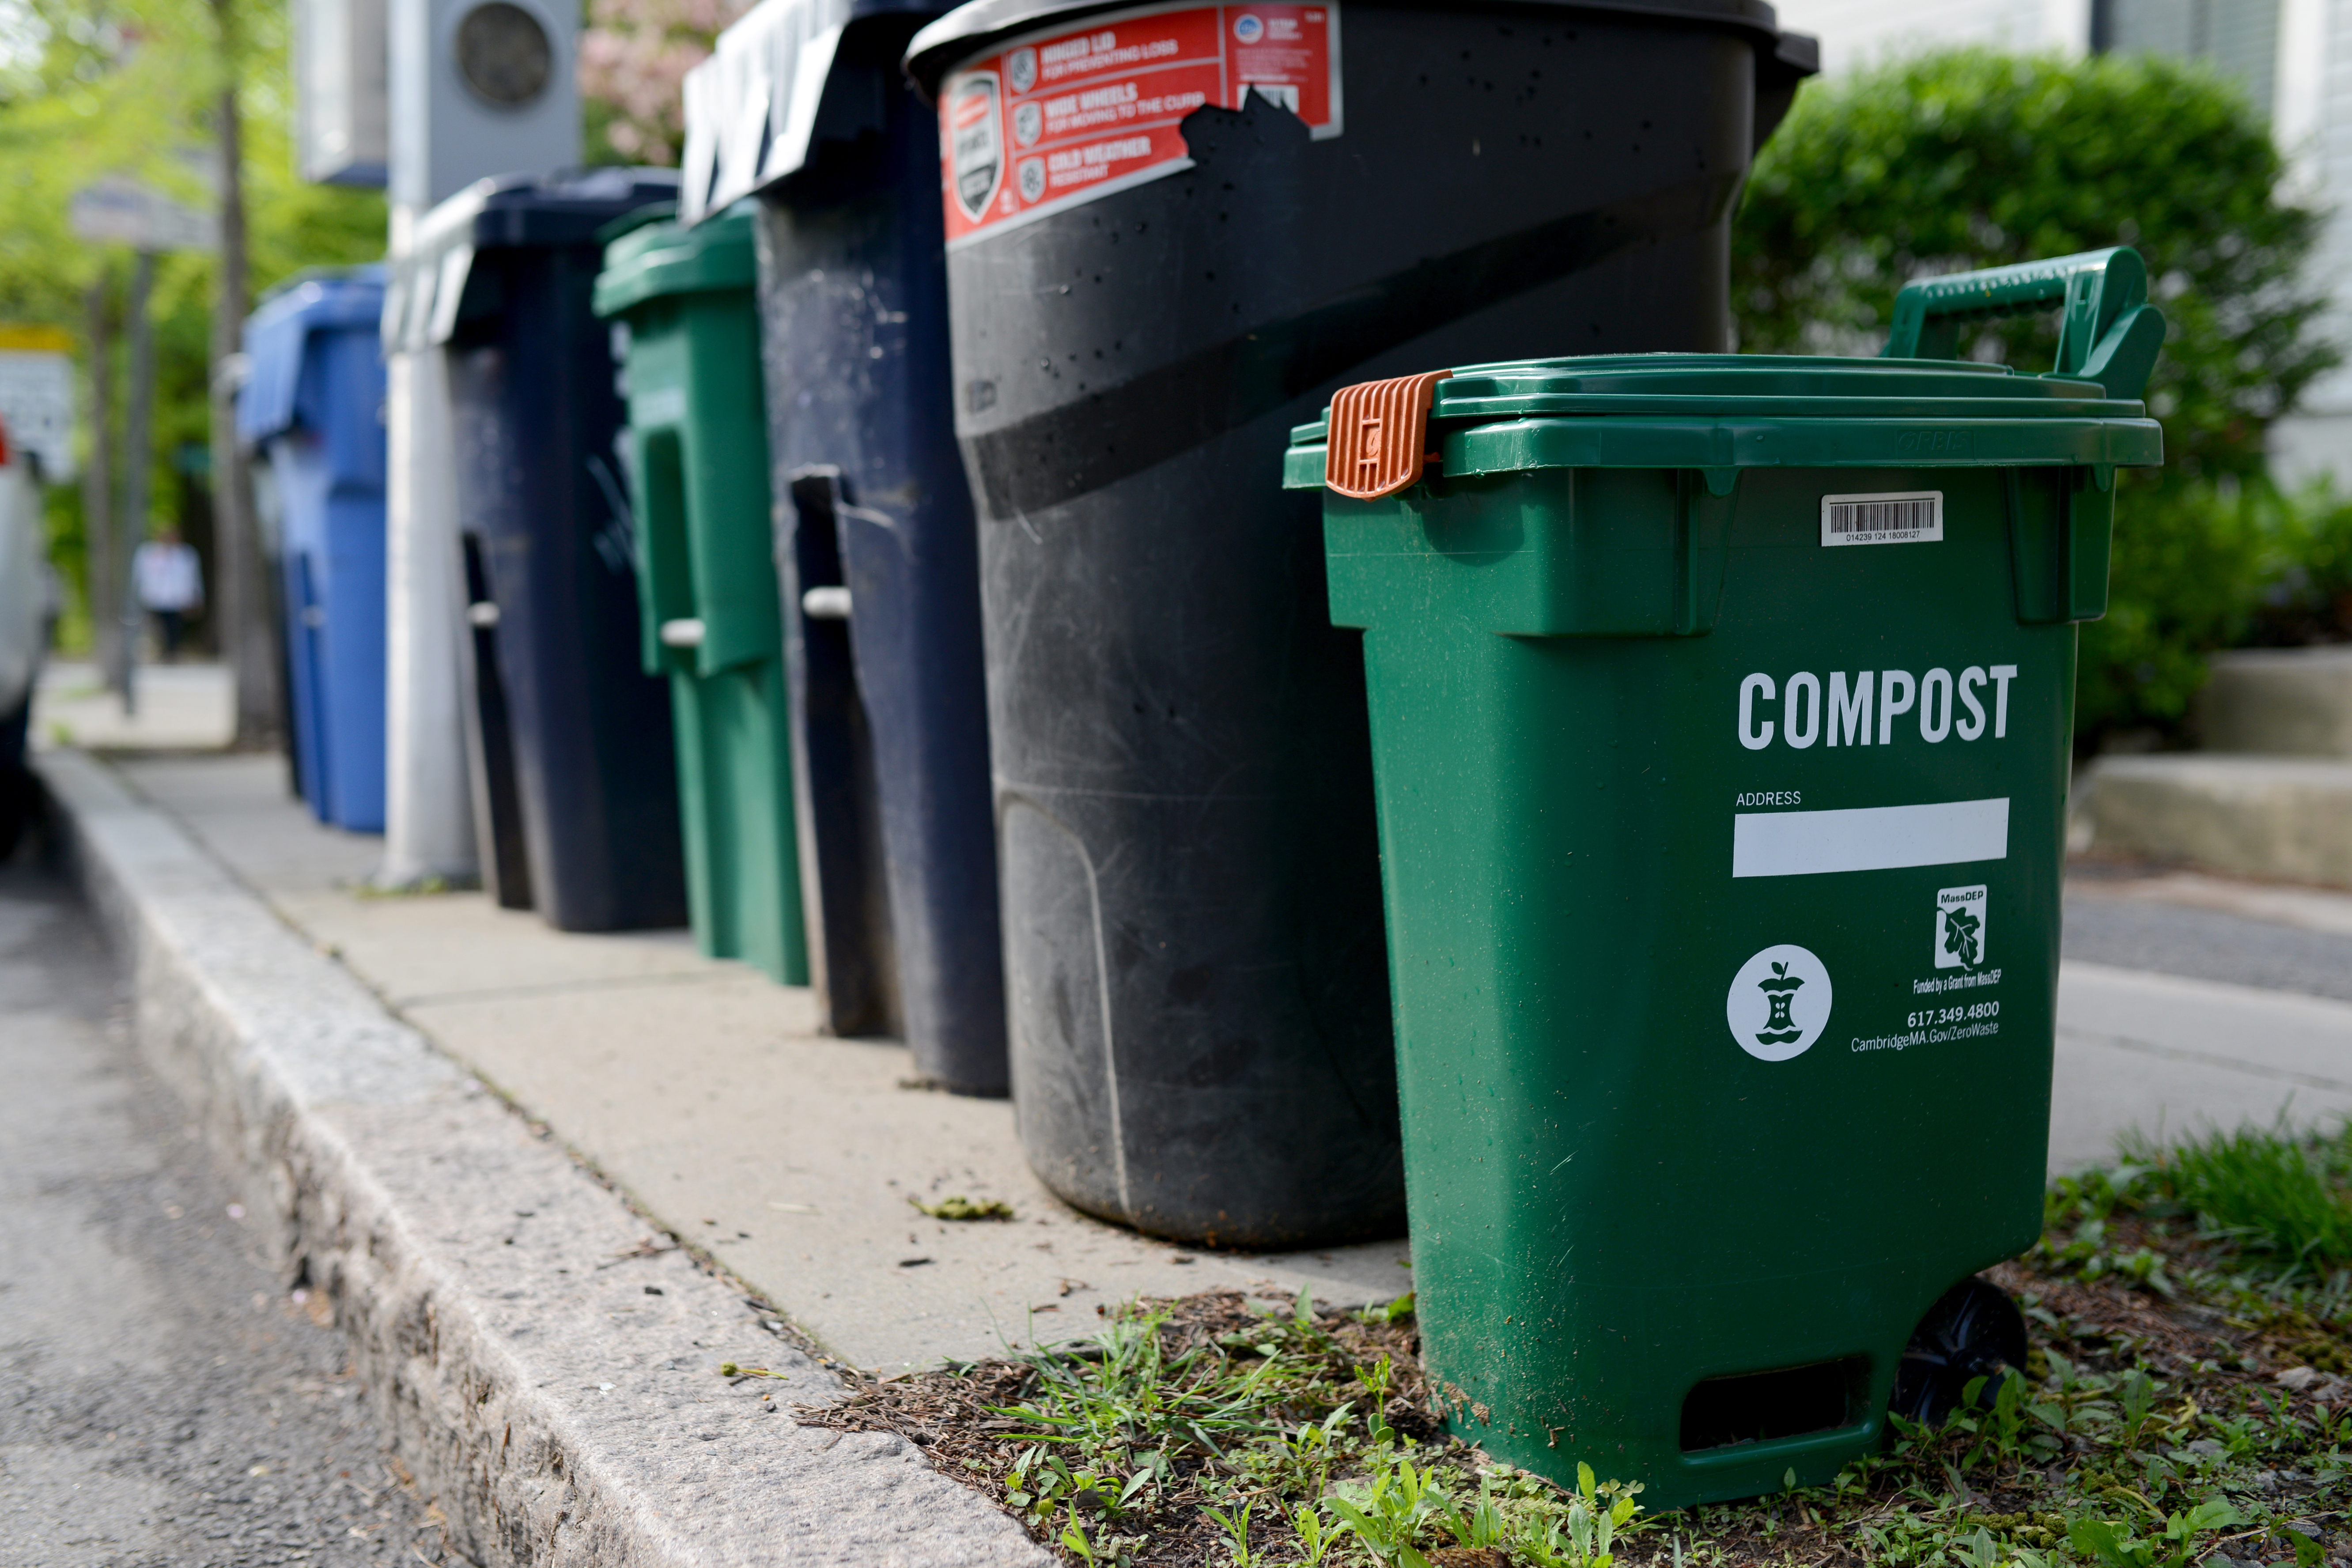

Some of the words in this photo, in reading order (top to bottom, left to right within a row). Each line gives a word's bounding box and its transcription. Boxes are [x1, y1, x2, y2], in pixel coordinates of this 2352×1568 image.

[1090, 31, 1116, 53] LID
[1065, 45, 1141, 76] PREVENTING
[1141, 38, 1178, 59] LOSS
[1079, 82, 1138, 110] WHEELS
[1069, 106, 1118, 129] MOVING
[1118, 102, 1136, 118] TO
[1136, 96, 1163, 116] THE
[1083, 135, 1151, 165] WEATHER
[1048, 162, 1109, 188] RESISTANT
[1898, 431, 1970, 450] ORBIS
[1846, 533, 1872, 541] 014239
[1889, 530, 1920, 539] 18008127
[1739, 665, 2017, 750] COMPOST
[1736, 791, 1801, 807] ADDRESS
[1941, 891, 1983, 903] MassDEP
[1913, 977, 1935, 994] Funded
[1936, 977, 1943, 995] by
[1944, 979, 1947, 990] a
[1948, 975, 1963, 990] Grant
[1964, 973, 1977, 989] from
[1977, 968, 2001, 987] MassDEP
[1907, 1001, 2000, 1028] 617.349.4800
[1851, 1021, 1999, 1052] CambridgeMA.Gov/ZeroWaste
